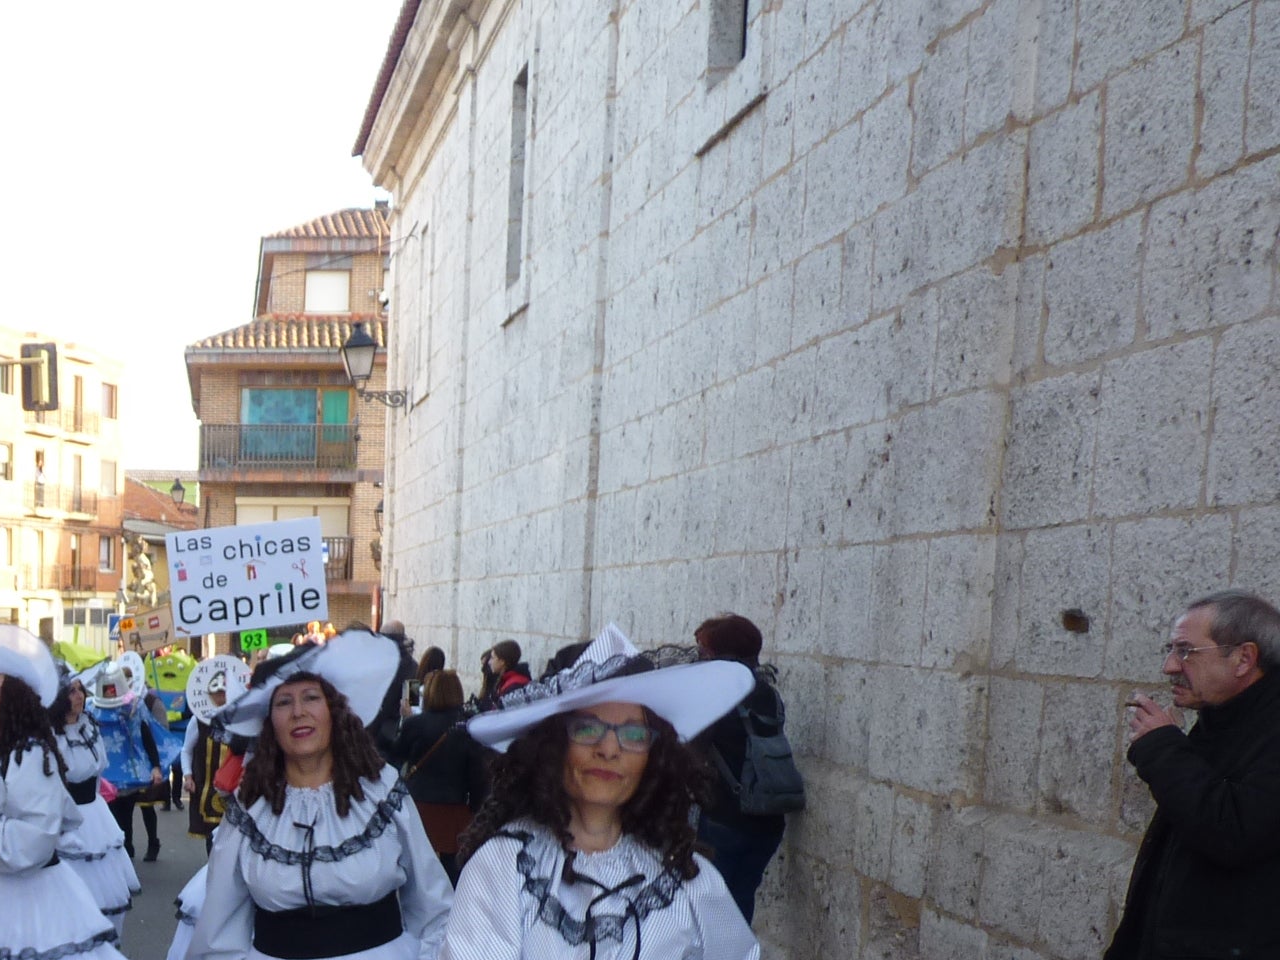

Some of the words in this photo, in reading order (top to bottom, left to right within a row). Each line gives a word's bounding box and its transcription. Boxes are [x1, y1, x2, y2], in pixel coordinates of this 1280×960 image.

[174, 535, 212, 553] Las
[223, 534, 311, 560] chicas
[202, 572, 228, 590] de
[179, 582, 320, 625] Caprile
[244, 633, 262, 648] 93
